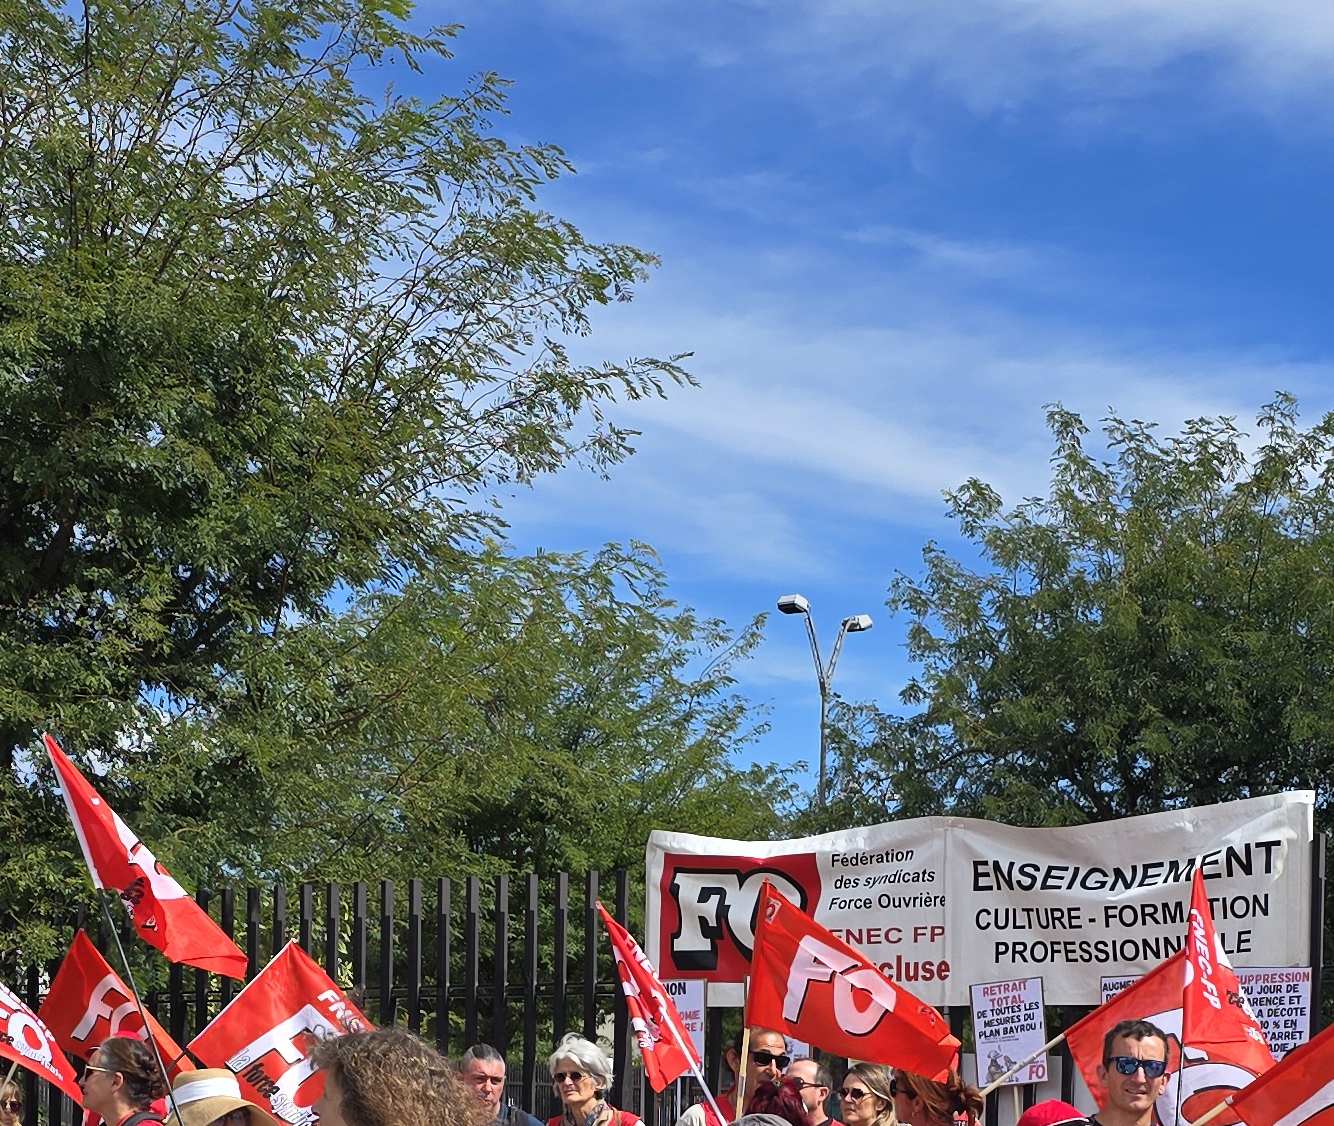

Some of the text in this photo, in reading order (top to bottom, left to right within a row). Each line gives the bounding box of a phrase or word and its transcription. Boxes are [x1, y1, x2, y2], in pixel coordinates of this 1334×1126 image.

[831, 849, 914, 867] Fédération
[972, 840, 1281, 891] ENSEIGNEMENT
[834, 869, 935, 889] des syndicats
[829, 892, 945, 910] Force Ouvrière
[669, 867, 807, 970] FO
[975, 907, 1082, 930] CULTURE
[1104, 894, 1269, 928] FORMTION
[913, 926, 945, 943] FP
[995, 930, 1251, 963] PROFESSIONNLE
[782, 934, 897, 1037] FO
[983, 979, 1027, 997] RETRAIT
[1257, 984, 1282, 995] JOUR
[1286, 984, 1299, 994] DE
[989, 994, 1025, 1008] TOTAL
[1247, 995, 1302, 1006] ARENCE ET
[977, 1001, 1040, 1019] DE TOUTES LES
[1267, 1004, 1306, 1018] DÉCOTE
[983, 1012, 1035, 1028] MESURES DU
[1284, 1019, 1297, 1029] EN
[979, 1028, 1001, 1039] PLAN
[1003, 1023, 1037, 1036] BAYROU
[242, 1062, 281, 1098] force
[1028, 1064, 1046, 1080] FO
